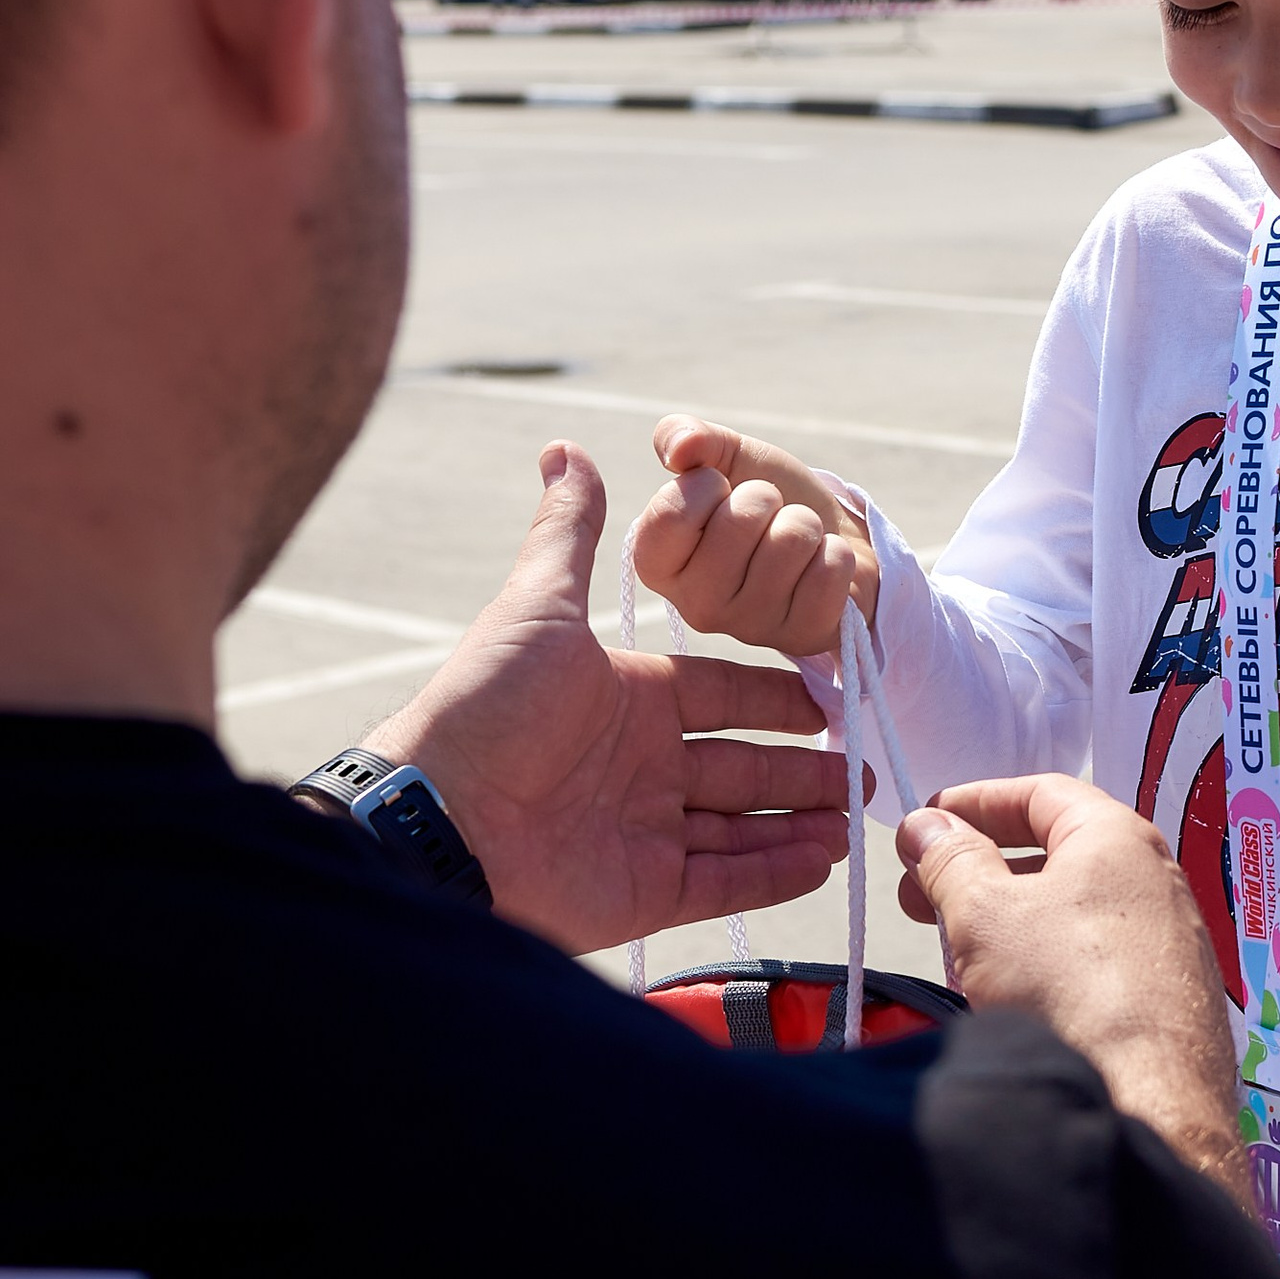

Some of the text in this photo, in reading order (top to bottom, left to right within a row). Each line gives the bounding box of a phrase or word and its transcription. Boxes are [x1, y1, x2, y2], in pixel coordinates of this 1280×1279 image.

[1235, 605, 1262, 775] СЕТЕВЫЕ
[1243, 825, 1264, 935] World Class
